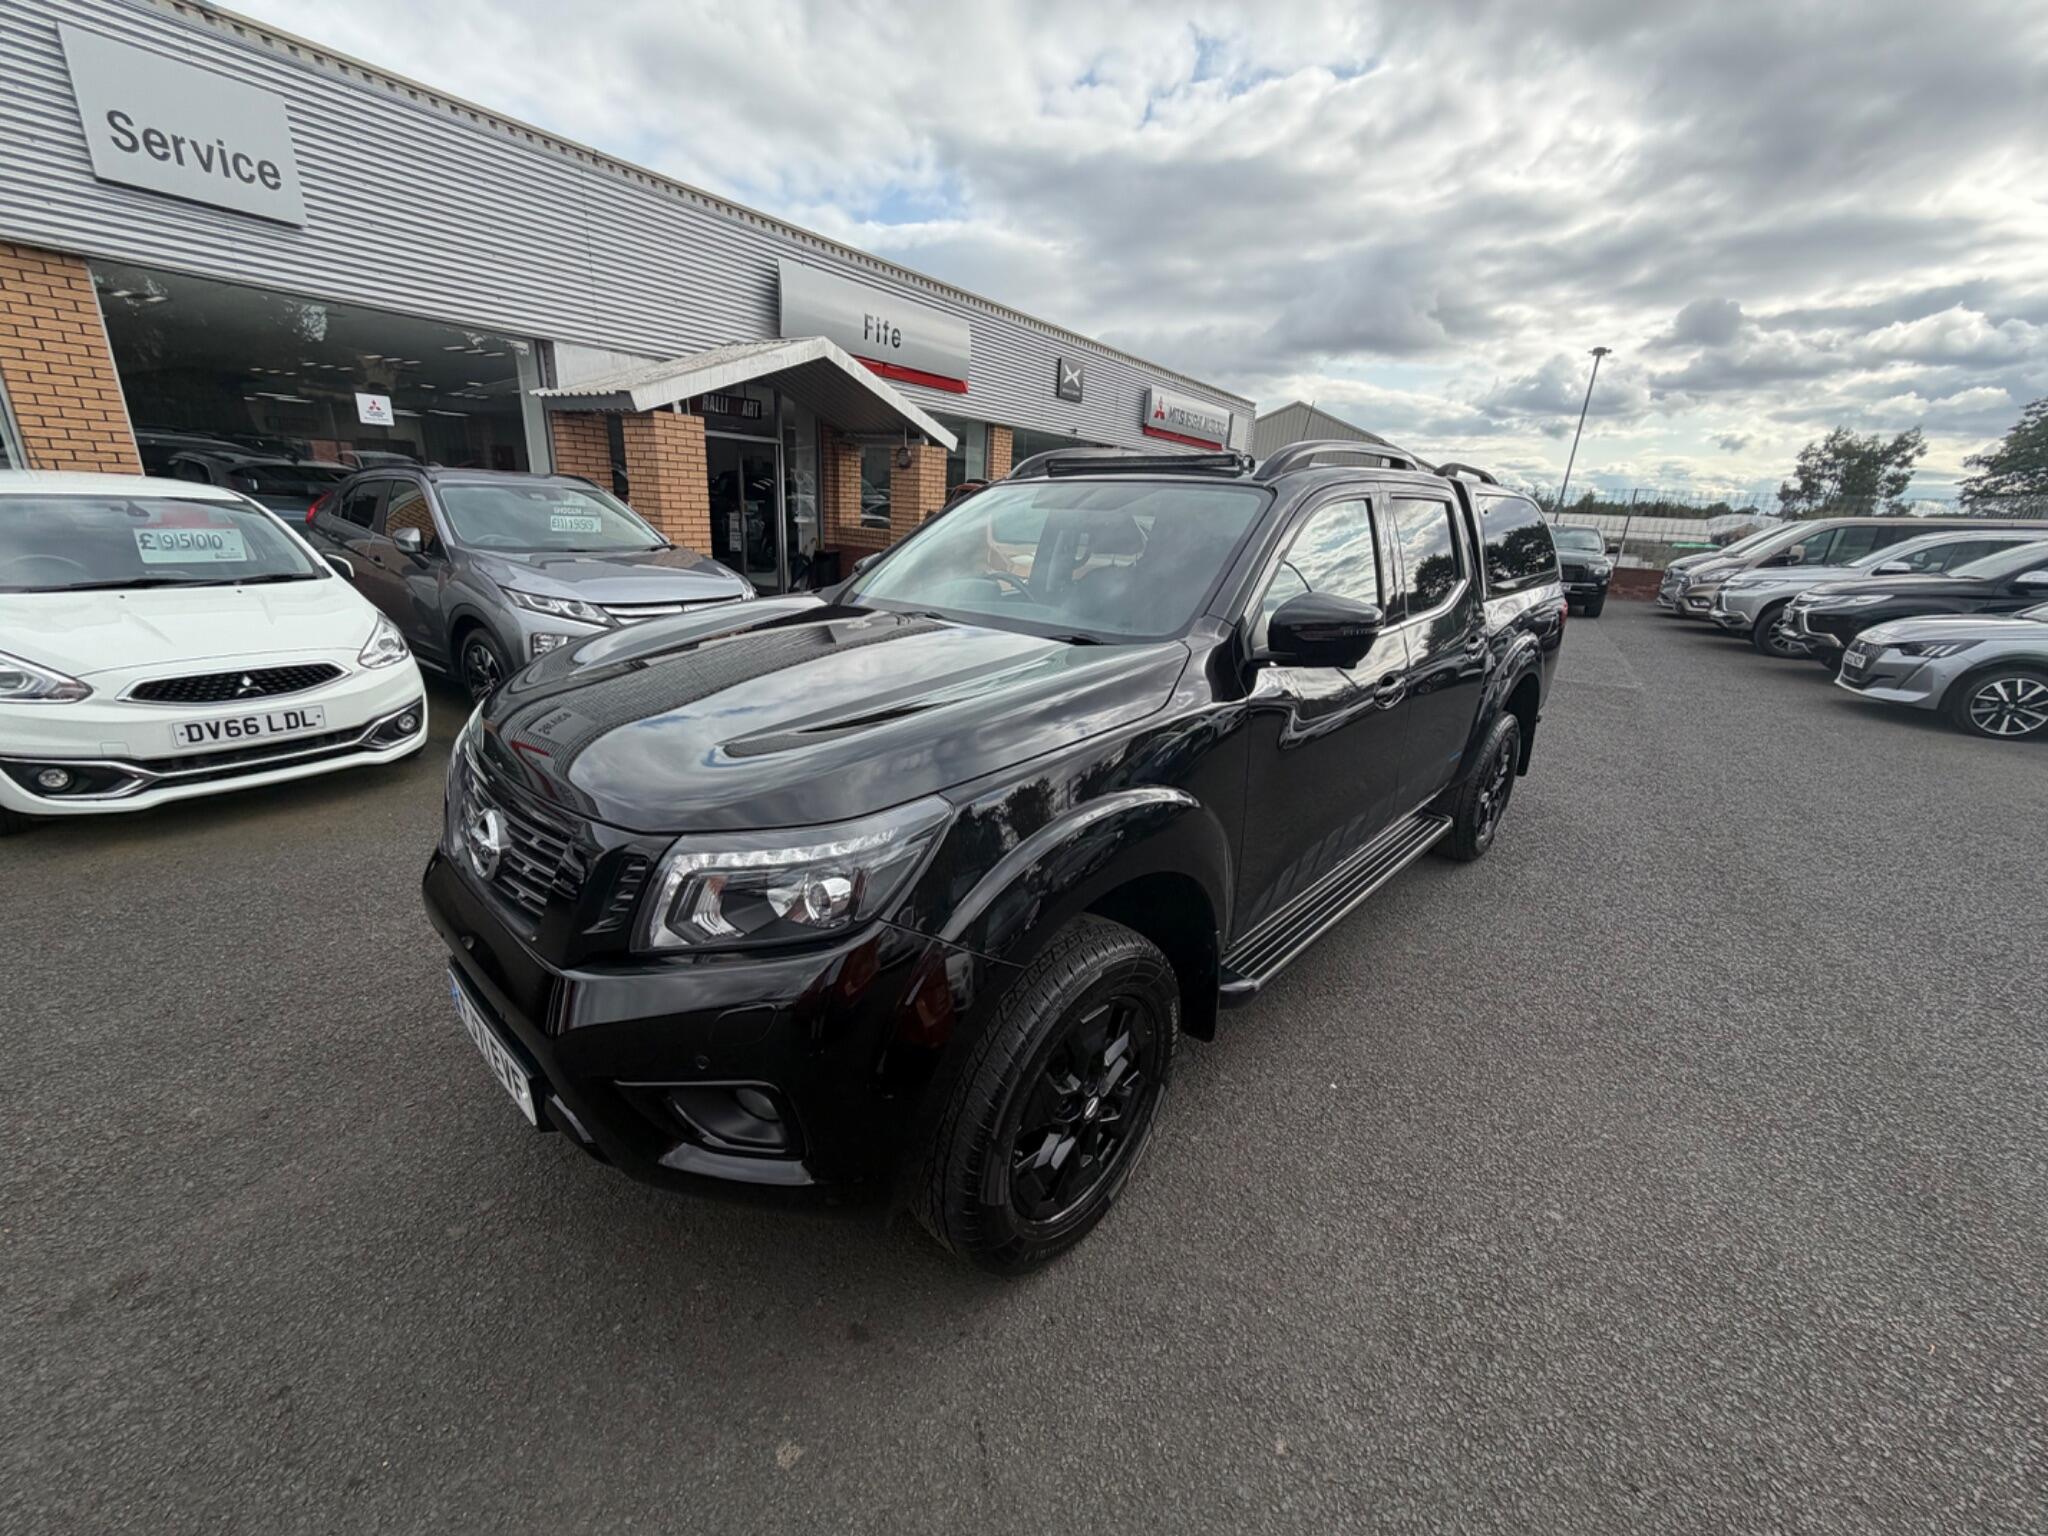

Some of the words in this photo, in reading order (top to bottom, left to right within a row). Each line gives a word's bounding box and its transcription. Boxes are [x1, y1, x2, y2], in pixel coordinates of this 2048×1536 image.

[106, 110, 282, 191] Service
[864, 313, 902, 348] Fife
[742, 400, 760, 417] ART
[184, 716, 260, 743] DV66
[266, 710, 317, 732] LDL
